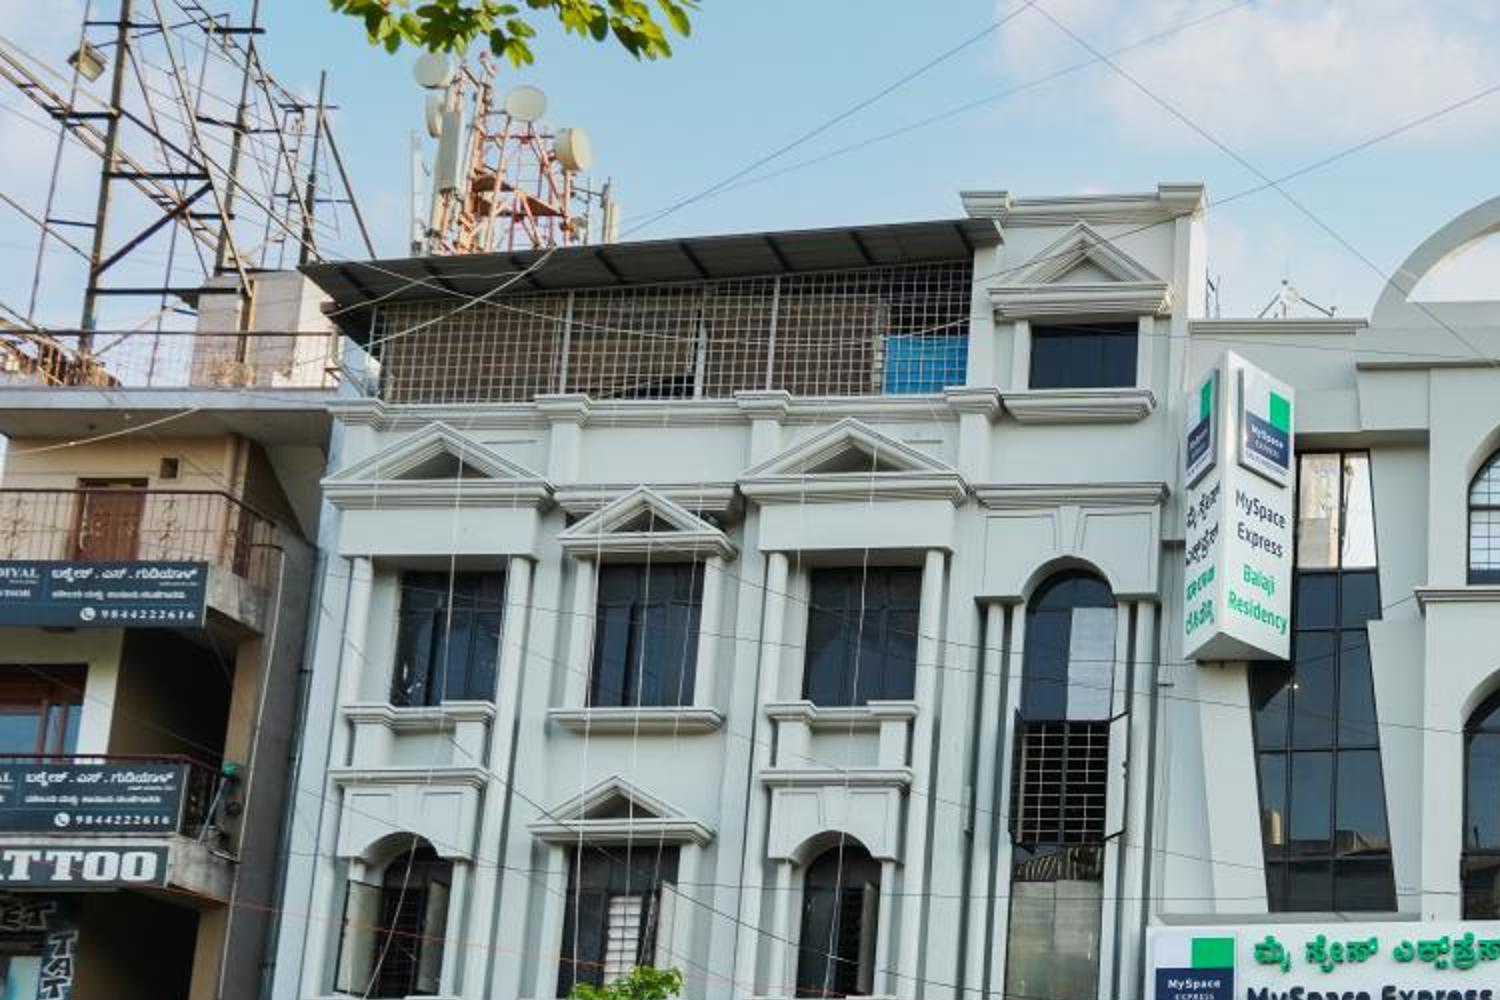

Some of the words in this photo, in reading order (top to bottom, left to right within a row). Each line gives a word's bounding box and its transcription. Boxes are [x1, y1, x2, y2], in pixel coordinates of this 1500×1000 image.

[1235, 488, 1287, 529] MySpace
[1237, 521, 1283, 558] Express
[1243, 564, 1275, 597] Balaji
[101, 611, 196, 620] 9844222616
[1228, 590, 1288, 635] Residency
[75, 815, 171, 825] 9844222616
[0, 850, 158, 881] TTOO
[1167, 978, 1221, 991] MySpace
